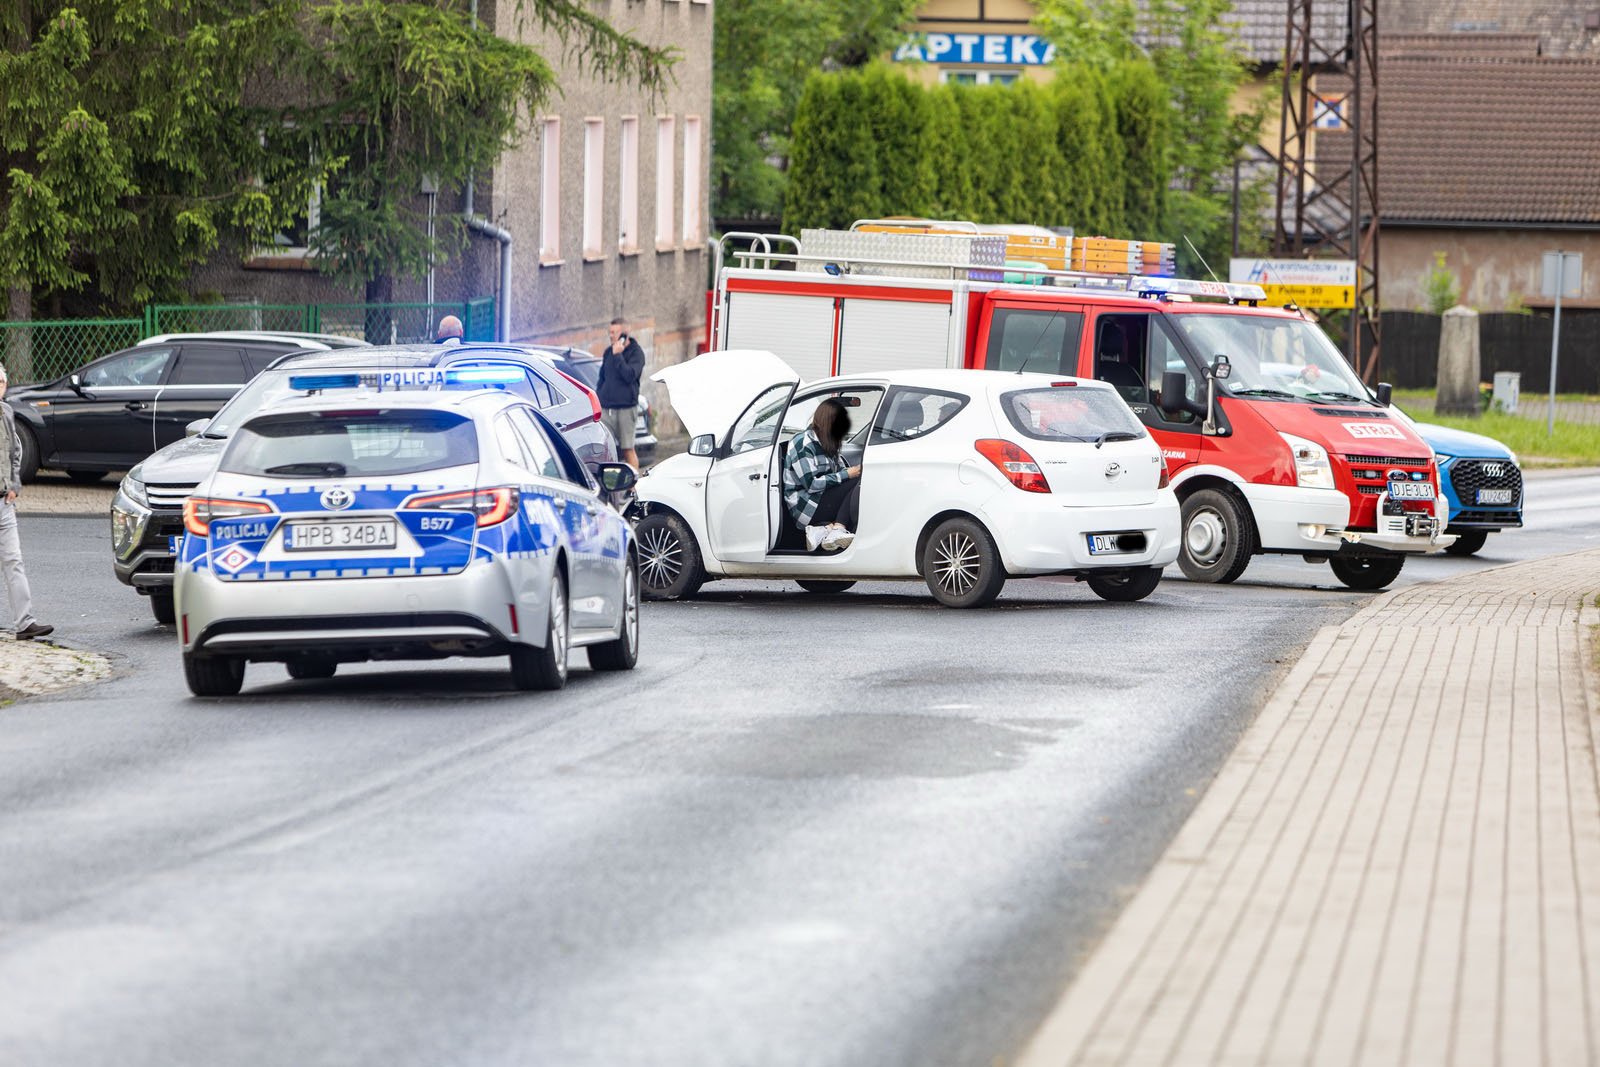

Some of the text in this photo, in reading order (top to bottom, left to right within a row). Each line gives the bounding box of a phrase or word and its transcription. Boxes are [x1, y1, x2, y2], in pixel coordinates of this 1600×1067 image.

[384, 371, 444, 385] POLICJA
[1162, 449, 1186, 459] ŻARNA
[1393, 483, 1433, 498] DJE 3L31
[216, 522, 269, 540] POLICJA
[420, 517, 455, 531] B577
[297, 525, 389, 546] HPB 34BA
[1095, 536, 1117, 551] DLW
